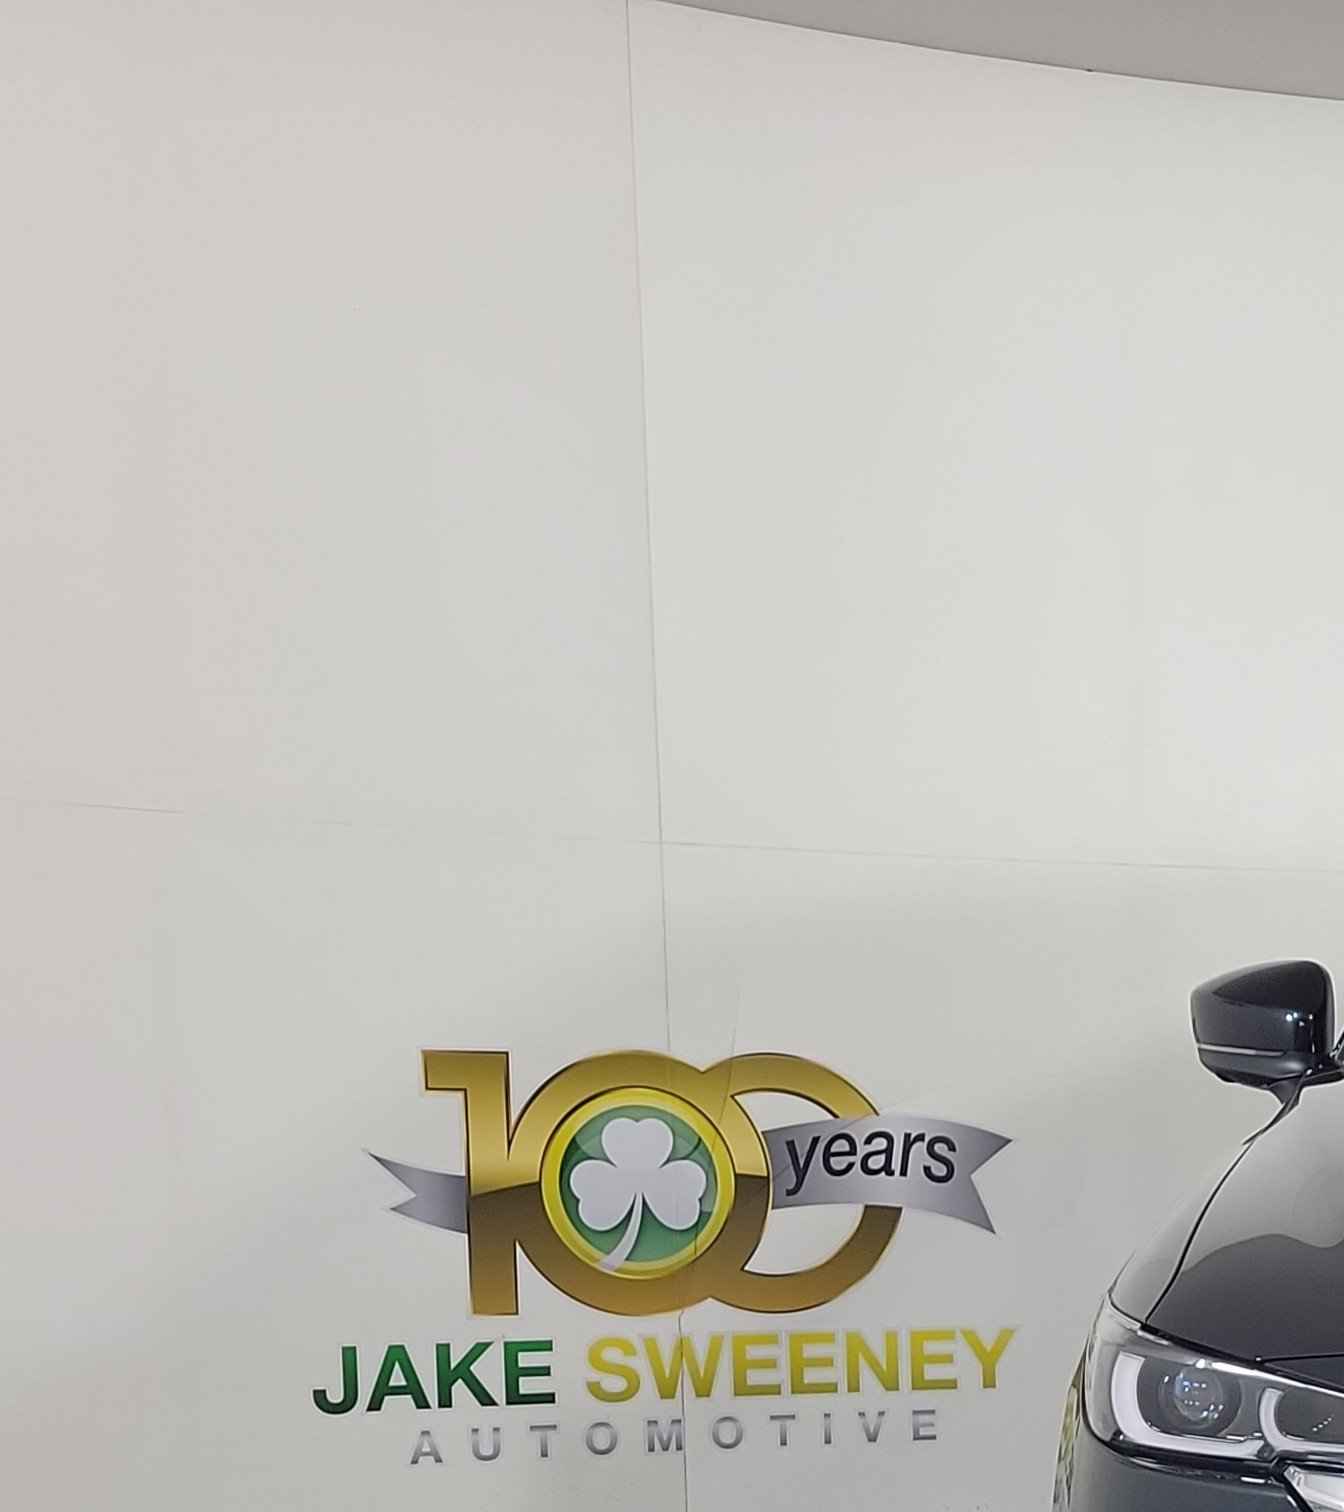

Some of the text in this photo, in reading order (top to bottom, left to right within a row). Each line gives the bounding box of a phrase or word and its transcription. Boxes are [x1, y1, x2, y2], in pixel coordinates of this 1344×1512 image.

[783, 1130, 957, 1197] years
[312, 1328, 1016, 1414] JAKE SWEENEY
[409, 1410, 939, 1465] AUTOMOTIVE
